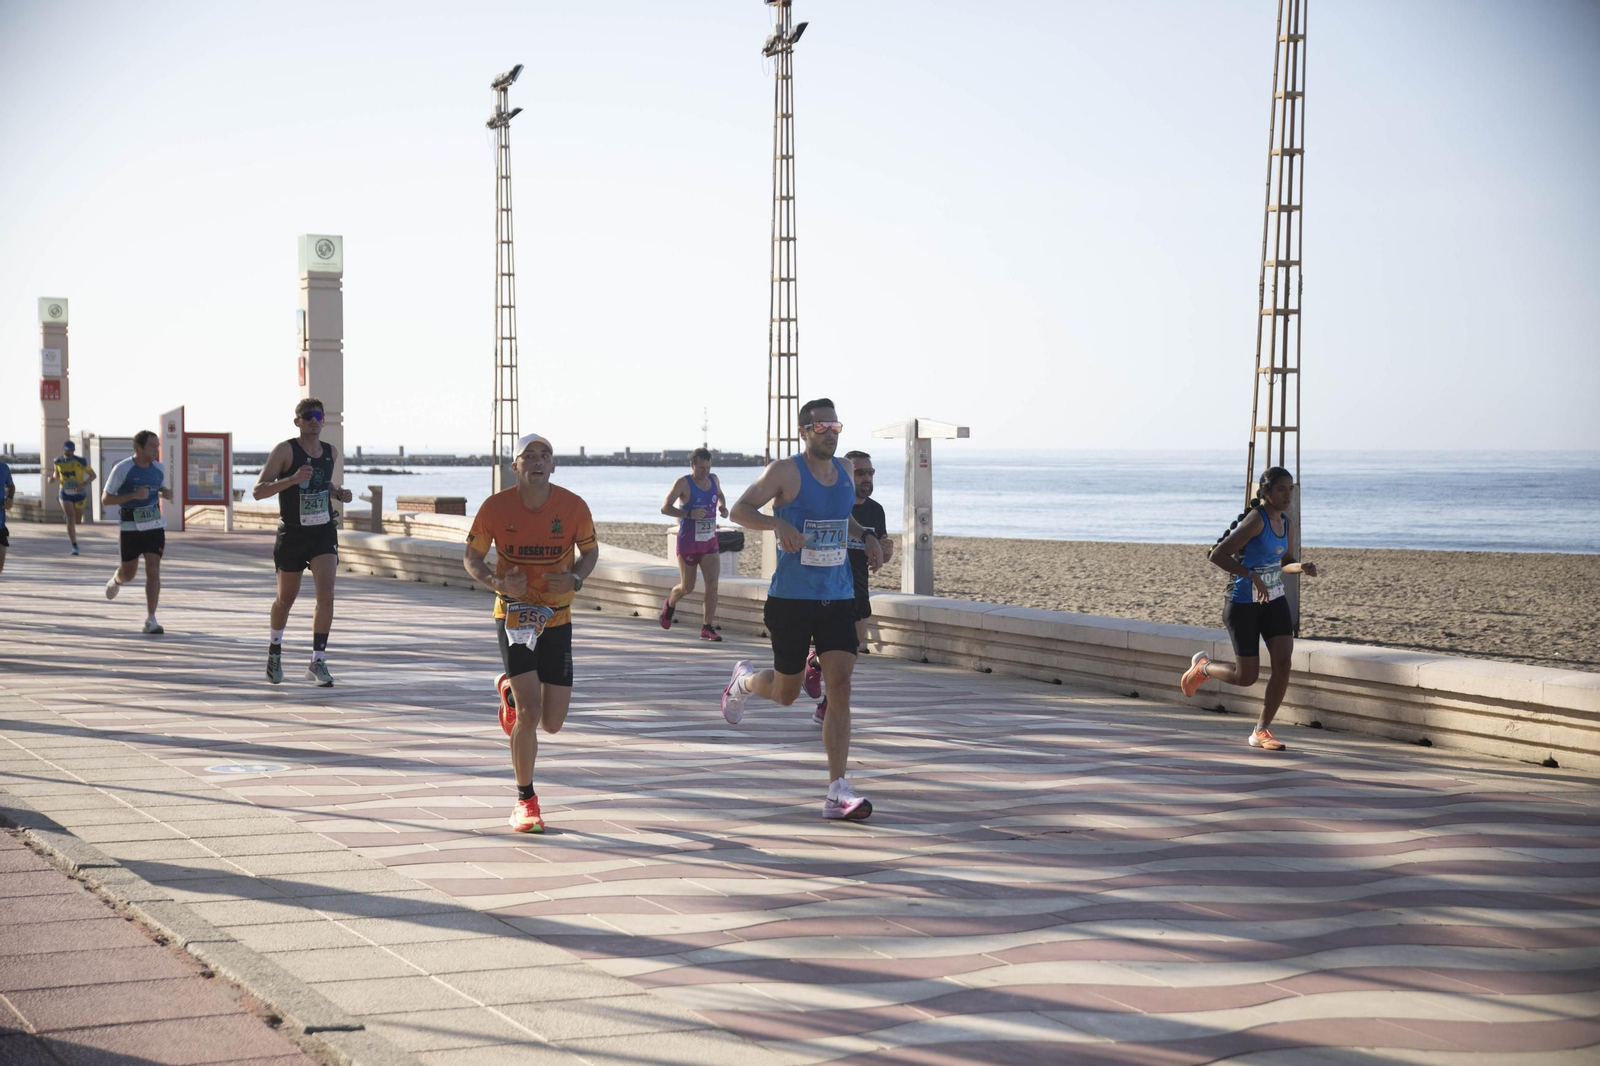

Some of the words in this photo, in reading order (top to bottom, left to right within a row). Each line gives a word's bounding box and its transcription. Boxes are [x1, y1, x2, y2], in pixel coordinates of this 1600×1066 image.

[304, 499, 324, 510] 247
[701, 523, 711, 531] 23
[504, 543, 514, 554] LA
